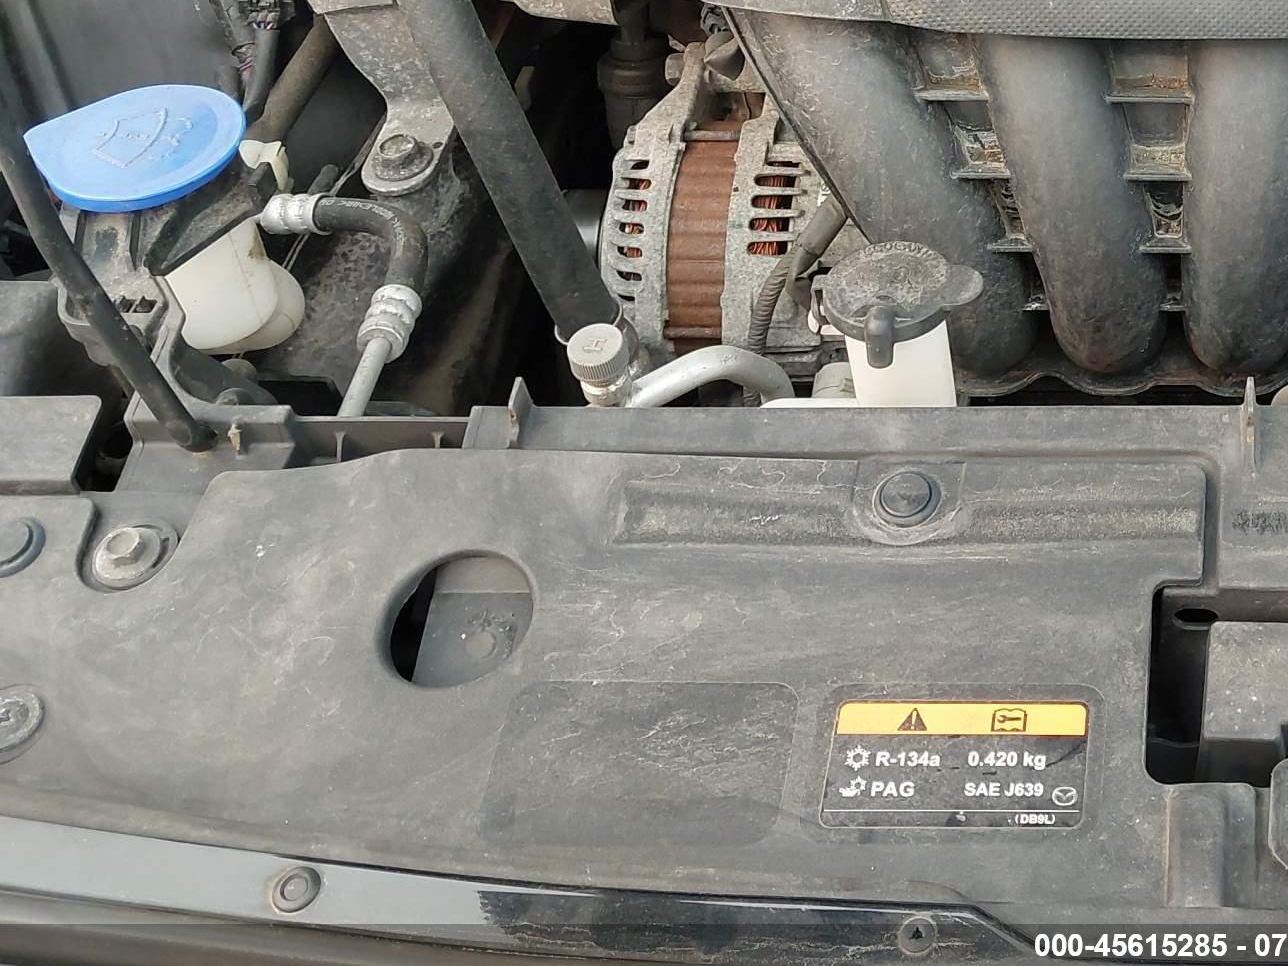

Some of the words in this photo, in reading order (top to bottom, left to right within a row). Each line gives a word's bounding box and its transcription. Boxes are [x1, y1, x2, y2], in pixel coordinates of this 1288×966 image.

[875, 751, 940, 767] R-134a
[967, 751, 1018, 767] 0.420
[1022, 751, 1046, 770] kg
[870, 782, 915, 797] PAG
[963, 782, 1001, 797] SAE
[1004, 782, 1044, 797] J639
